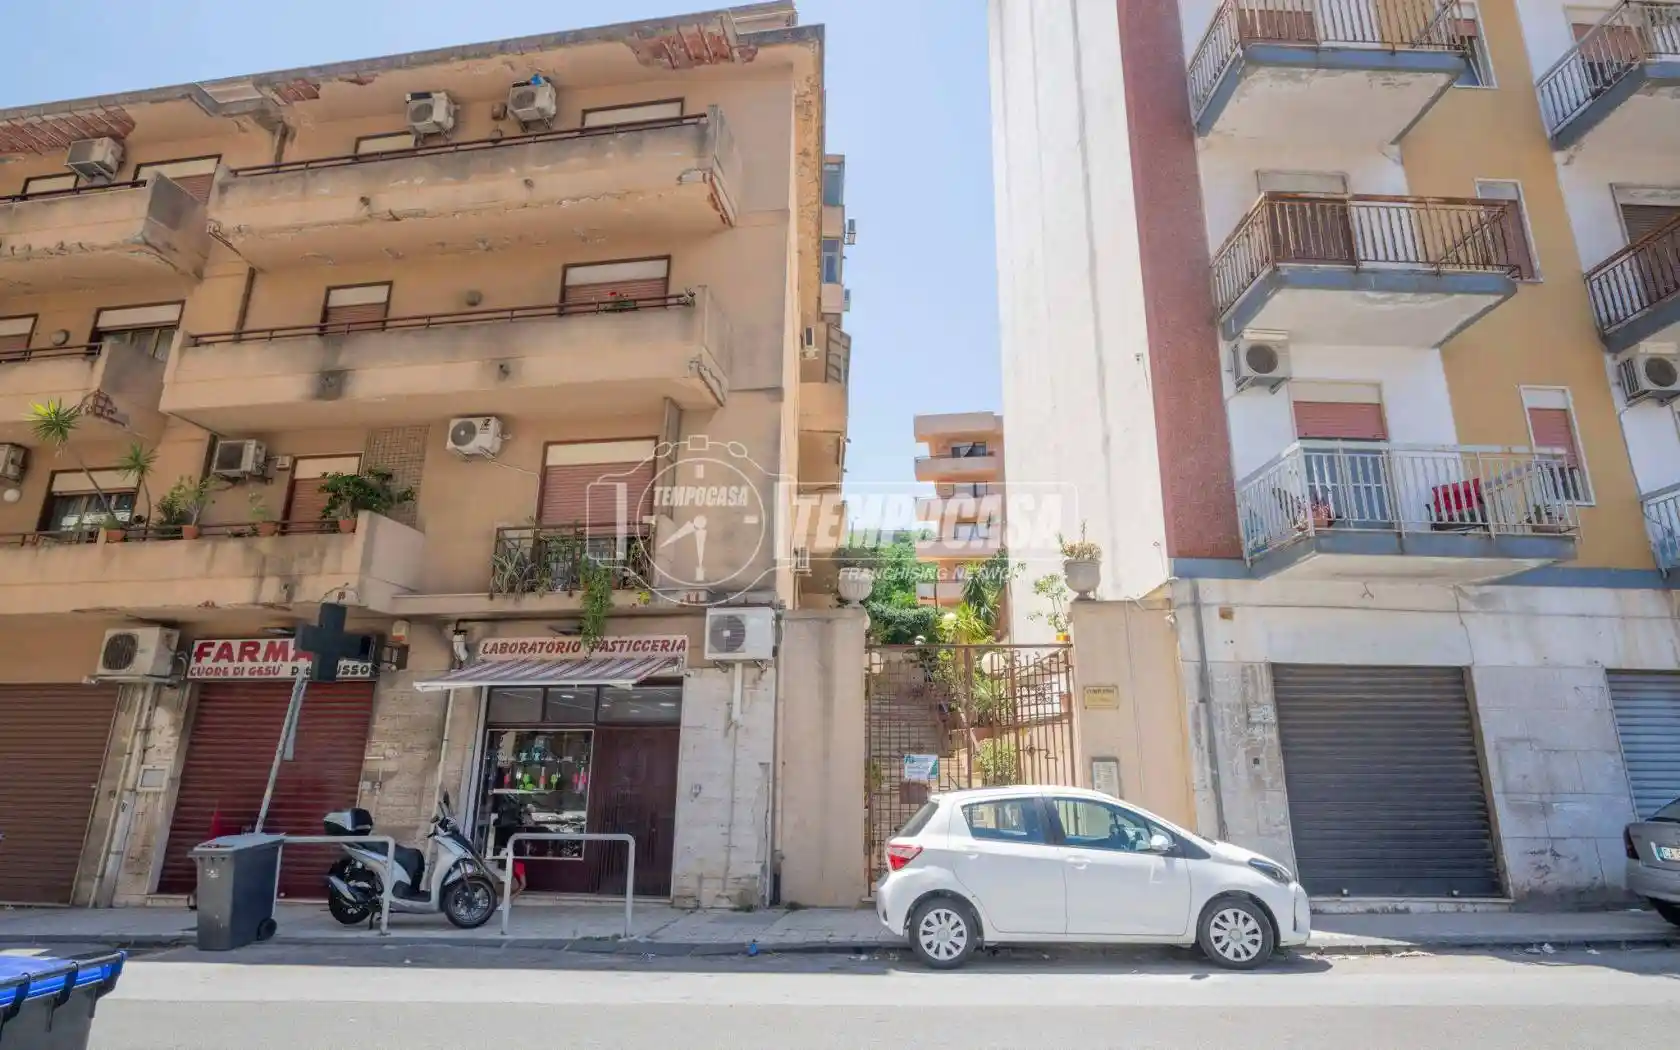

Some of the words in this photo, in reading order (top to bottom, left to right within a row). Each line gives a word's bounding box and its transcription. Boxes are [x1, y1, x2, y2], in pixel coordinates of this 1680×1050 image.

[482, 640, 582, 655] LABORATORIO
[591, 639, 687, 653] PASTICCERIA
[190, 665, 229, 677] CUORE
[232, 666, 244, 676] DI
